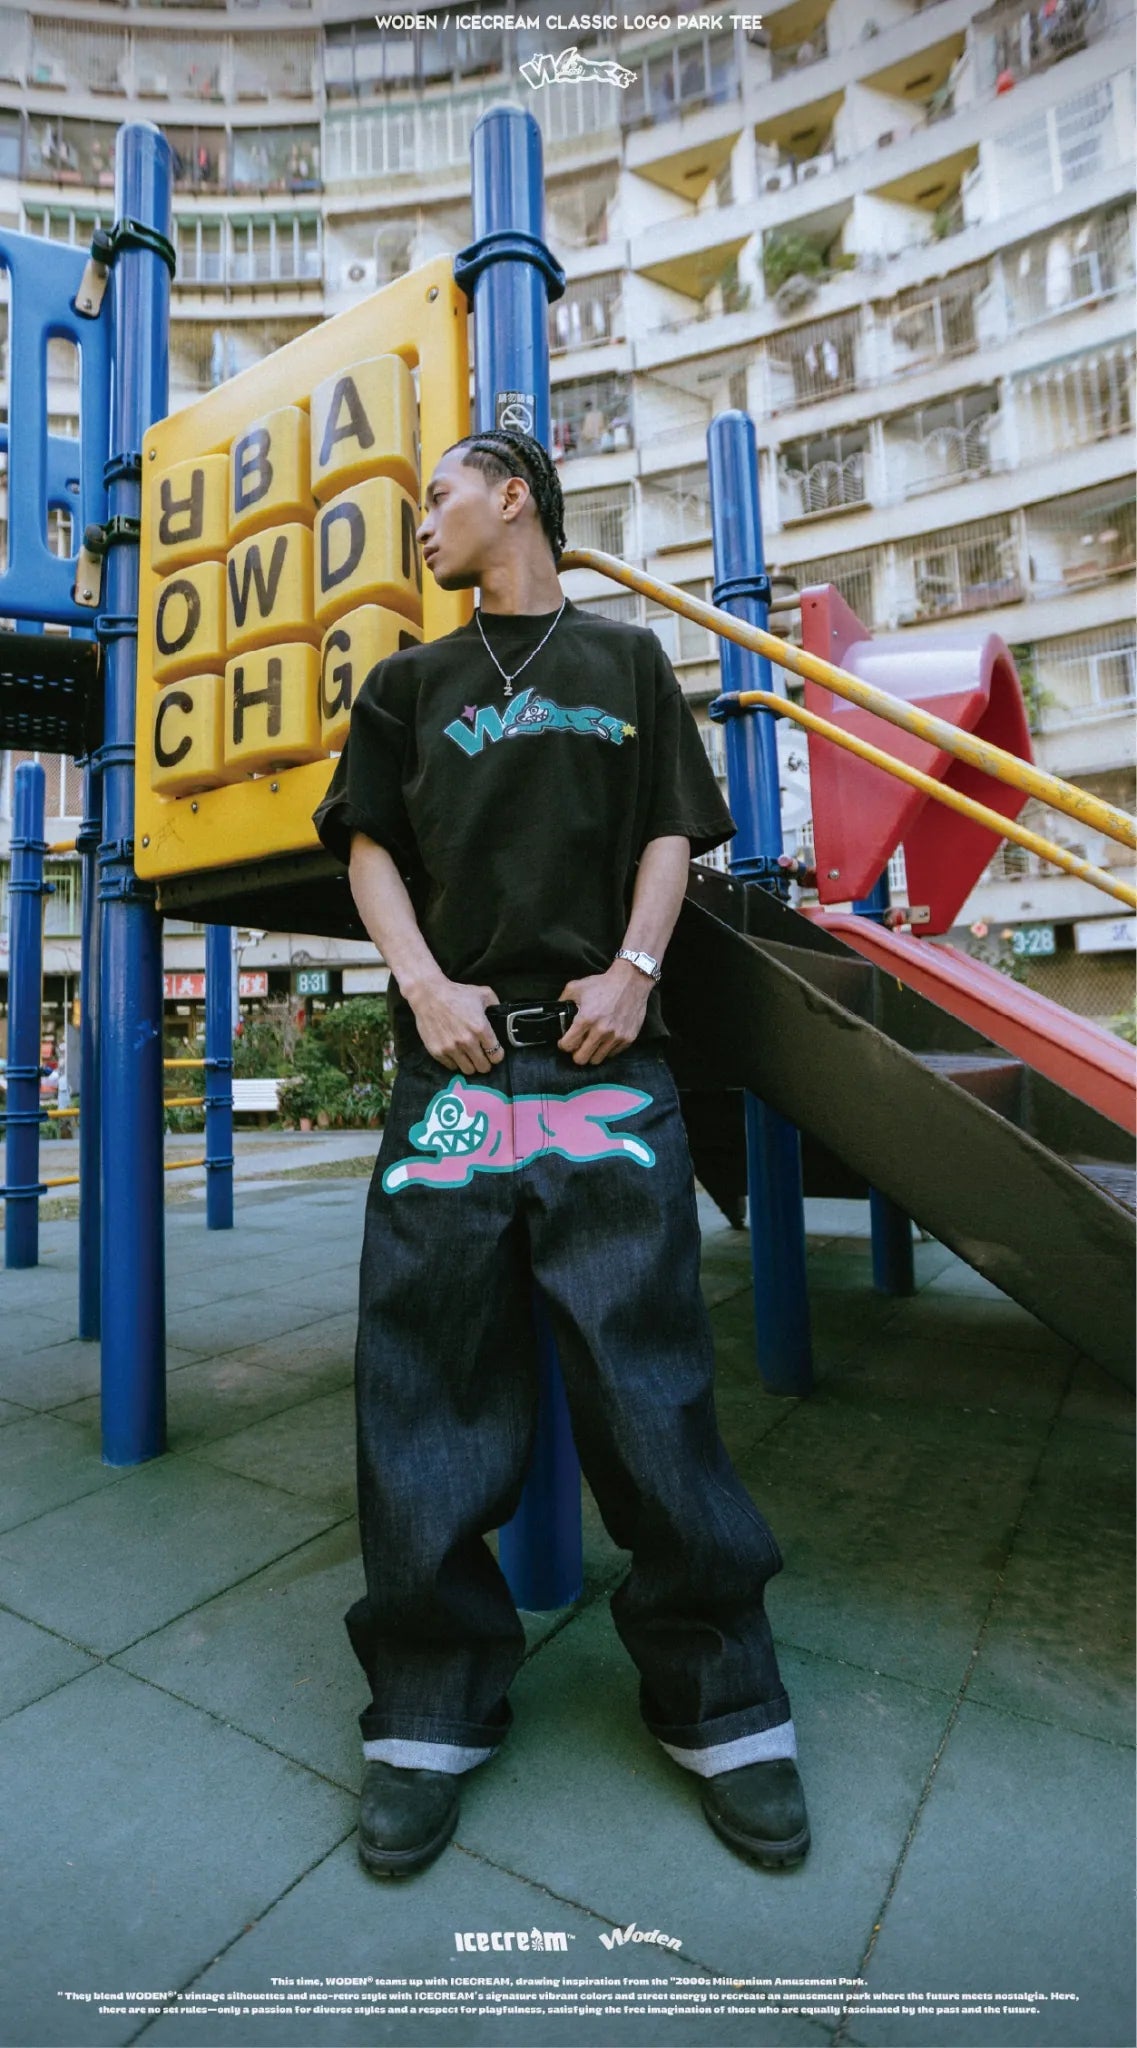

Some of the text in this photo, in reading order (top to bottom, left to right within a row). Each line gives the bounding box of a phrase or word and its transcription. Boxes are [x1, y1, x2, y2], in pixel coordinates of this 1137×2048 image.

[233, 427, 274, 514] B
[319, 376, 376, 467] A
[155, 580, 202, 657] O
[228, 535, 288, 628] W
[320, 501, 366, 594] D
[154, 690, 193, 768] C
[233, 657, 282, 745] H
